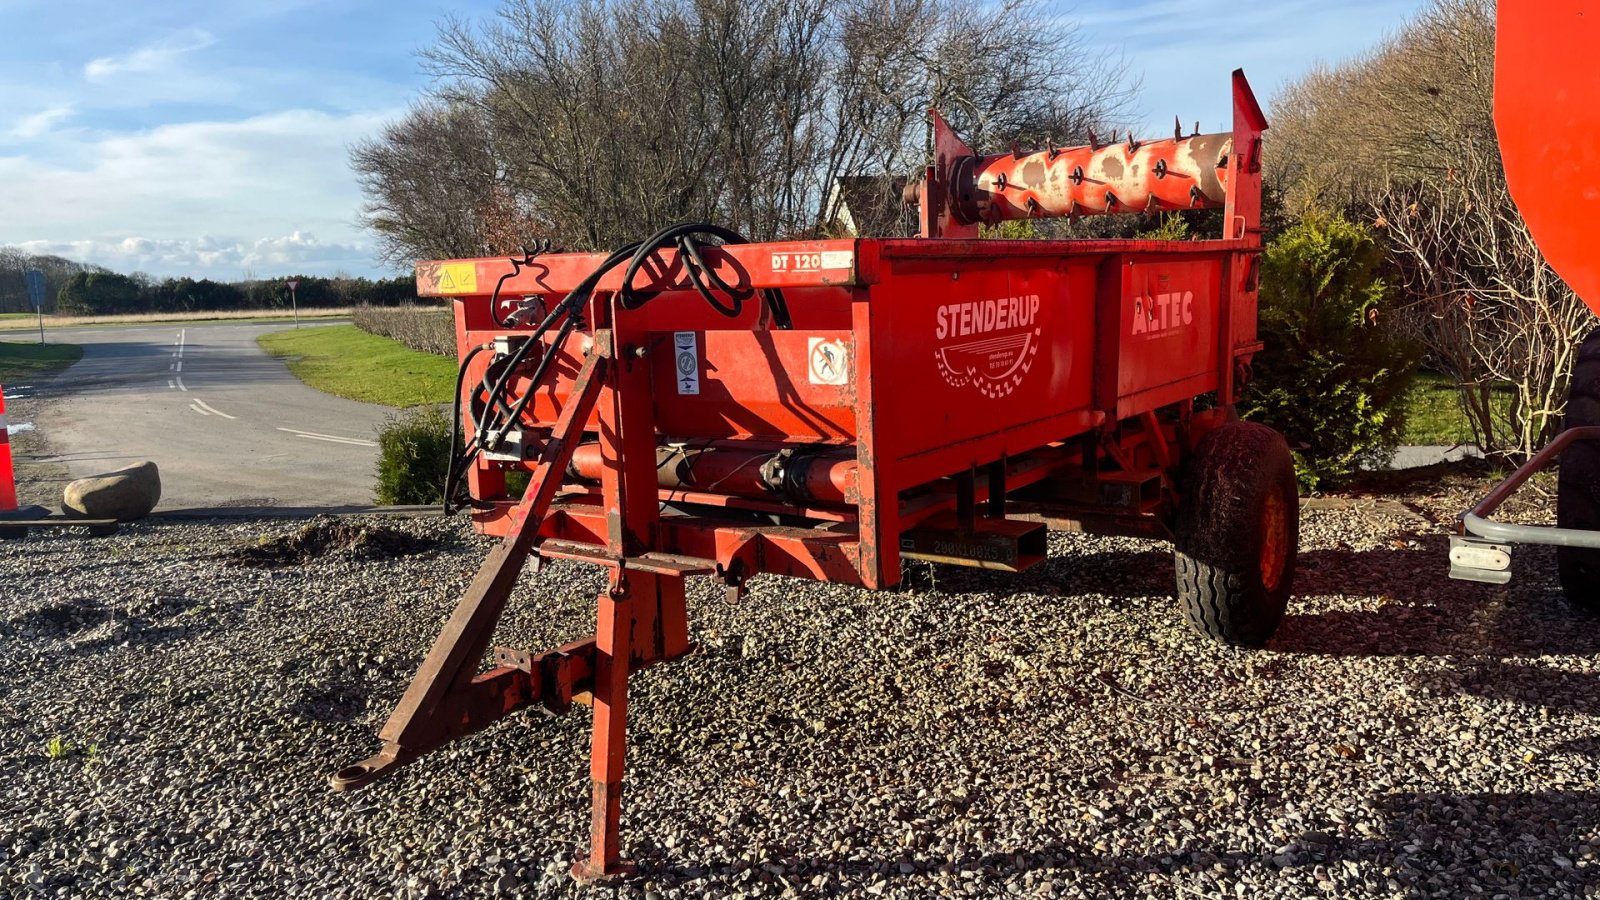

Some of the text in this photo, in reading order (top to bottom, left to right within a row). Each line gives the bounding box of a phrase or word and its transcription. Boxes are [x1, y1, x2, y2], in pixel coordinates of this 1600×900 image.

[772, 255, 820, 269] DT 120
[936, 294, 1040, 339] STENDERUP
